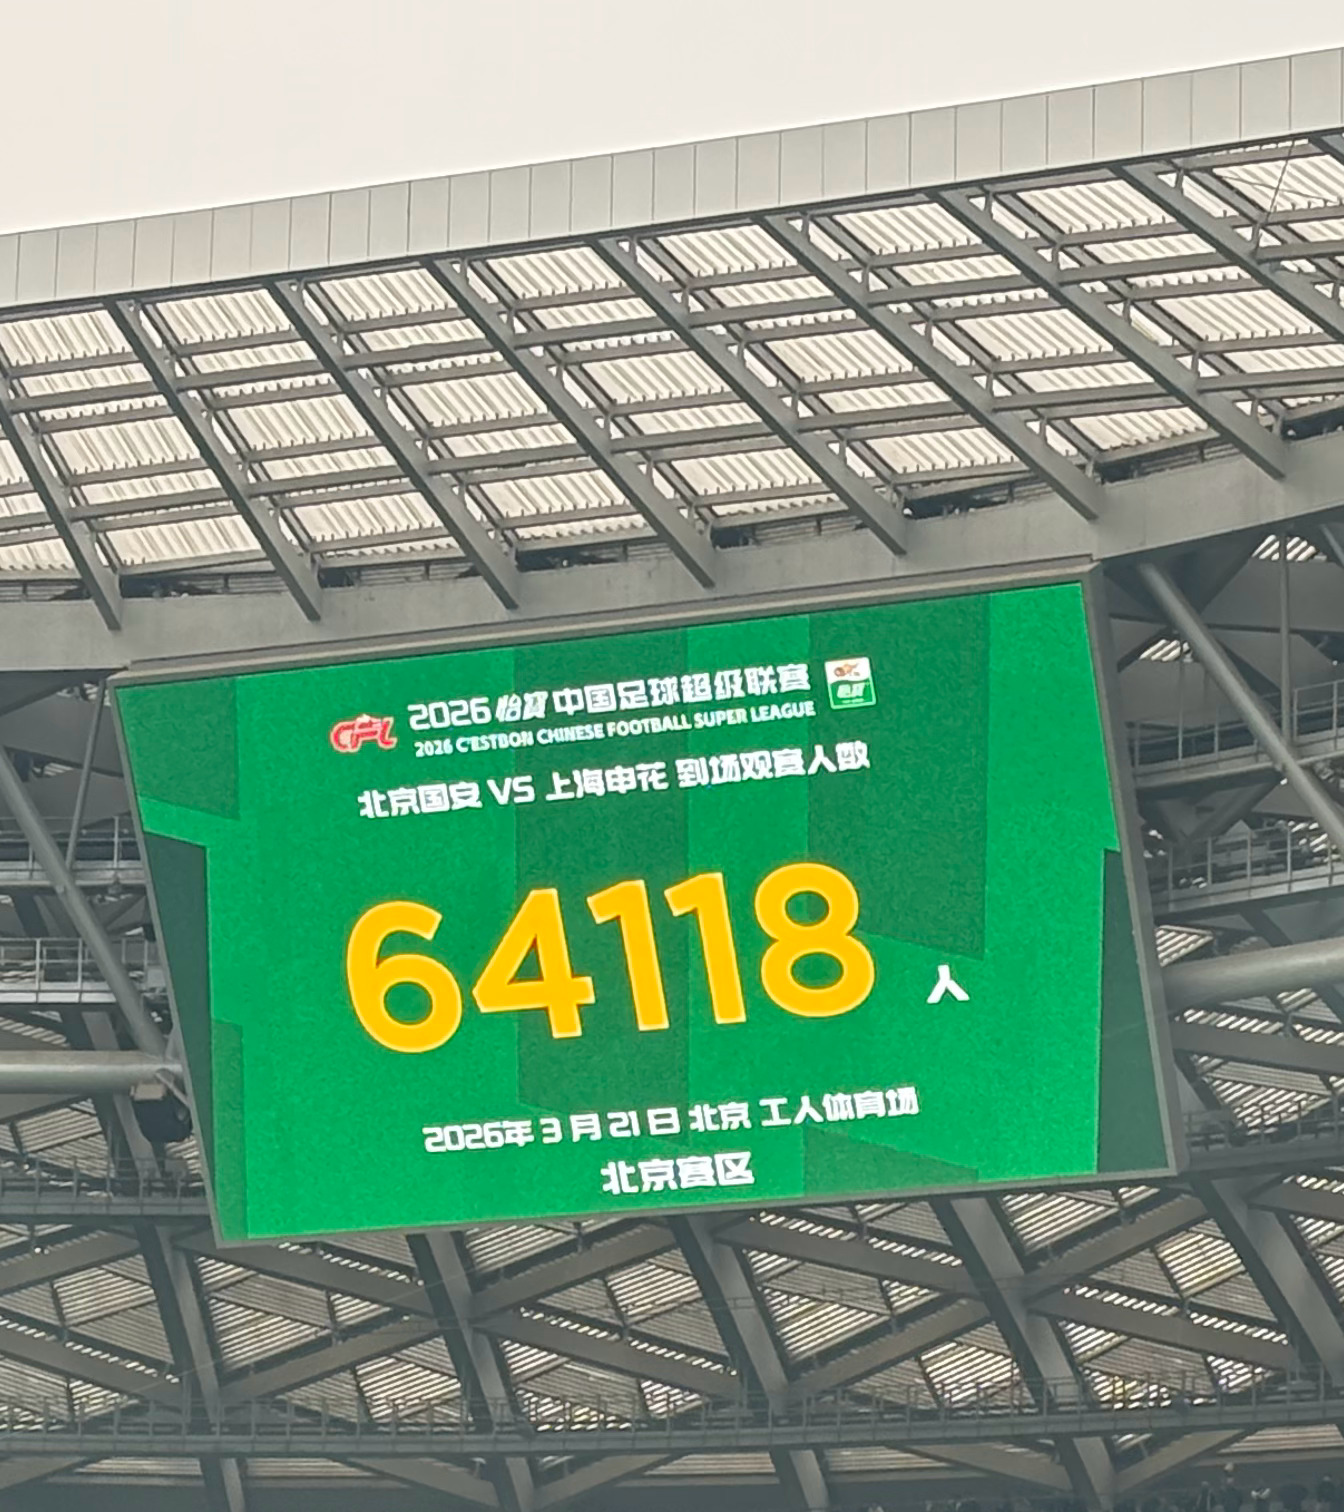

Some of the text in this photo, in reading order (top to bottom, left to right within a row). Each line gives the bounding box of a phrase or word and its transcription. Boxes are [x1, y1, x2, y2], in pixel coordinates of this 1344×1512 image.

[414, 740, 454, 758] 2026
[536, 723, 604, 744] CHINESE
[607, 713, 692, 738] FOOTBALL
[694, 707, 748, 729] SUPER
[750, 700, 816, 722] LEAGUE
[357, 739, 871, 819] 北京国安 VS 上海申花 到场观赛人数
[346, 862, 970, 1053] 64118 人
[600, 1150, 756, 1196] 北京赛区
